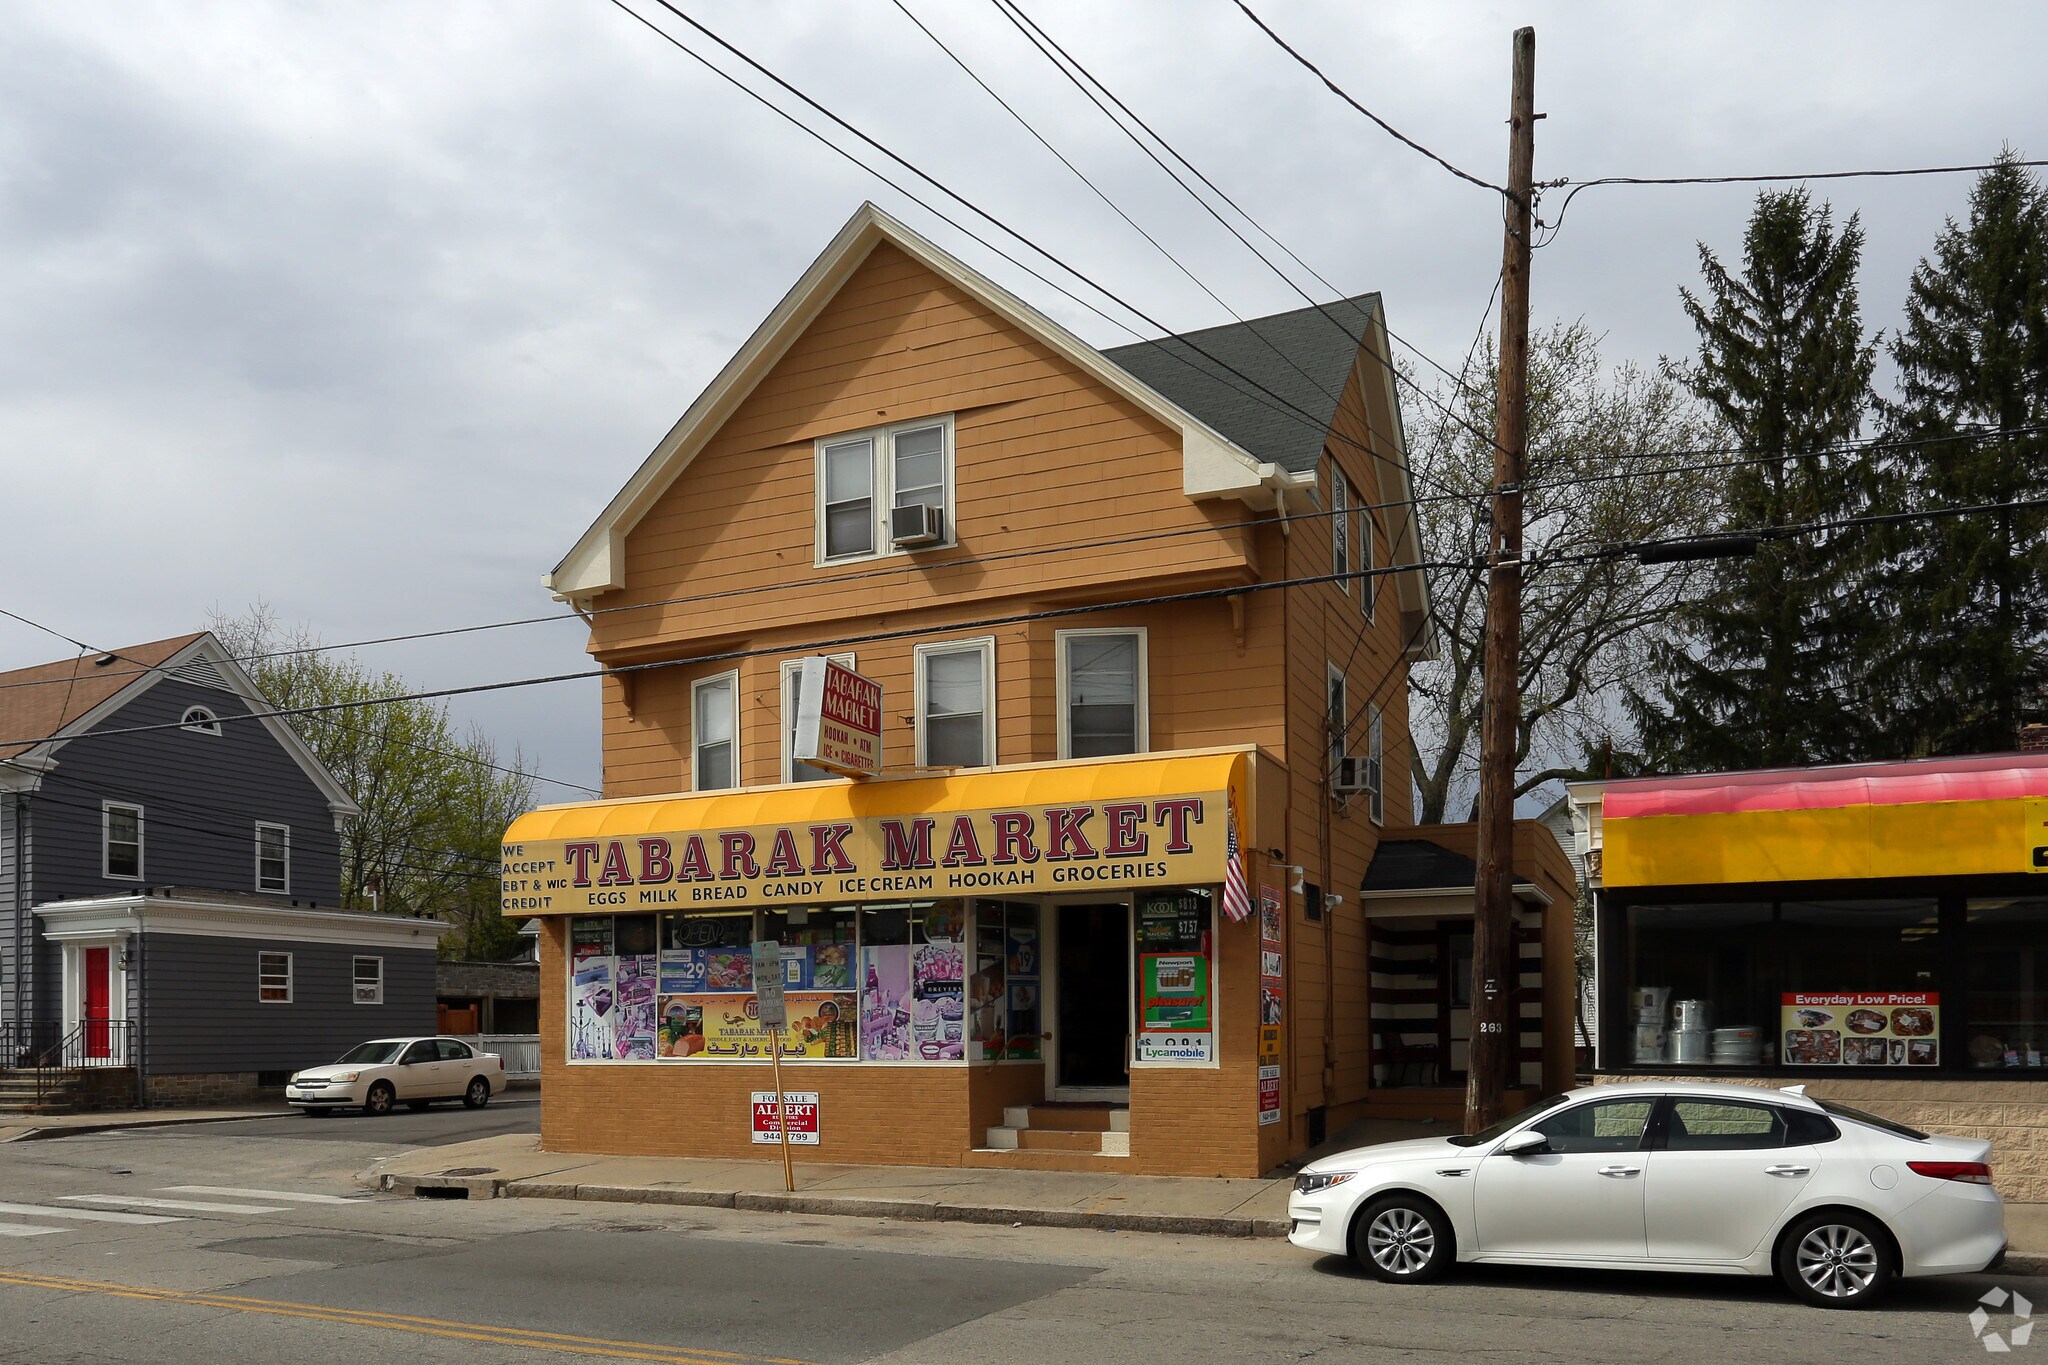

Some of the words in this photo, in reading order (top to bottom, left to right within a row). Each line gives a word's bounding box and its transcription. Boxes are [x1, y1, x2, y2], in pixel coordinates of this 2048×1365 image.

[826, 666, 879, 709] TABARAK
[825, 691, 876, 729] MARKET
[824, 725, 849, 745] HOOKAH
[860, 738, 872, 754] ATM
[823, 743, 833, 759] ICE
[841, 750, 874, 769] CIGARETTES
[564, 822, 857, 888] TABARAK
[880, 797, 1204, 871] MARKET
[502, 844, 524, 857] WE
[502, 860, 555, 875] ACCEPT
[502, 880, 528, 893] EBT
[532, 880, 542, 891] &
[547, 878, 568, 889] WIC
[588, 892, 627, 905] EGGS
[639, 889, 678, 904] MILK
[692, 885, 748, 901] BREAD
[762, 880, 824, 897] CANDY
[839, 878, 866, 893] ICE
[870, 875, 933, 892] CREAM
[949, 869, 1035, 888] HOOKAH
[1052, 861, 1168, 883] GROCERIES
[502, 896, 552, 910] CREDIT
[1146, 902, 1177, 913] KOOL
[679, 923, 721, 942] OPEN
[1019, 951, 1031, 967] 19
[764, 988, 777, 999] NO
[926, 985, 963, 993] BREYERS
[1795, 994, 1854, 1006] Everyday
[1857, 994, 1885, 1004] Low
[1888, 994, 1926, 1004] Price!
[718, 1028, 756, 1036] TABARAK
[1480, 1022, 1502, 1033] 263
[1146, 1048, 1205, 1058] Lycamobile
[783, 1095, 808, 1103] SALE
